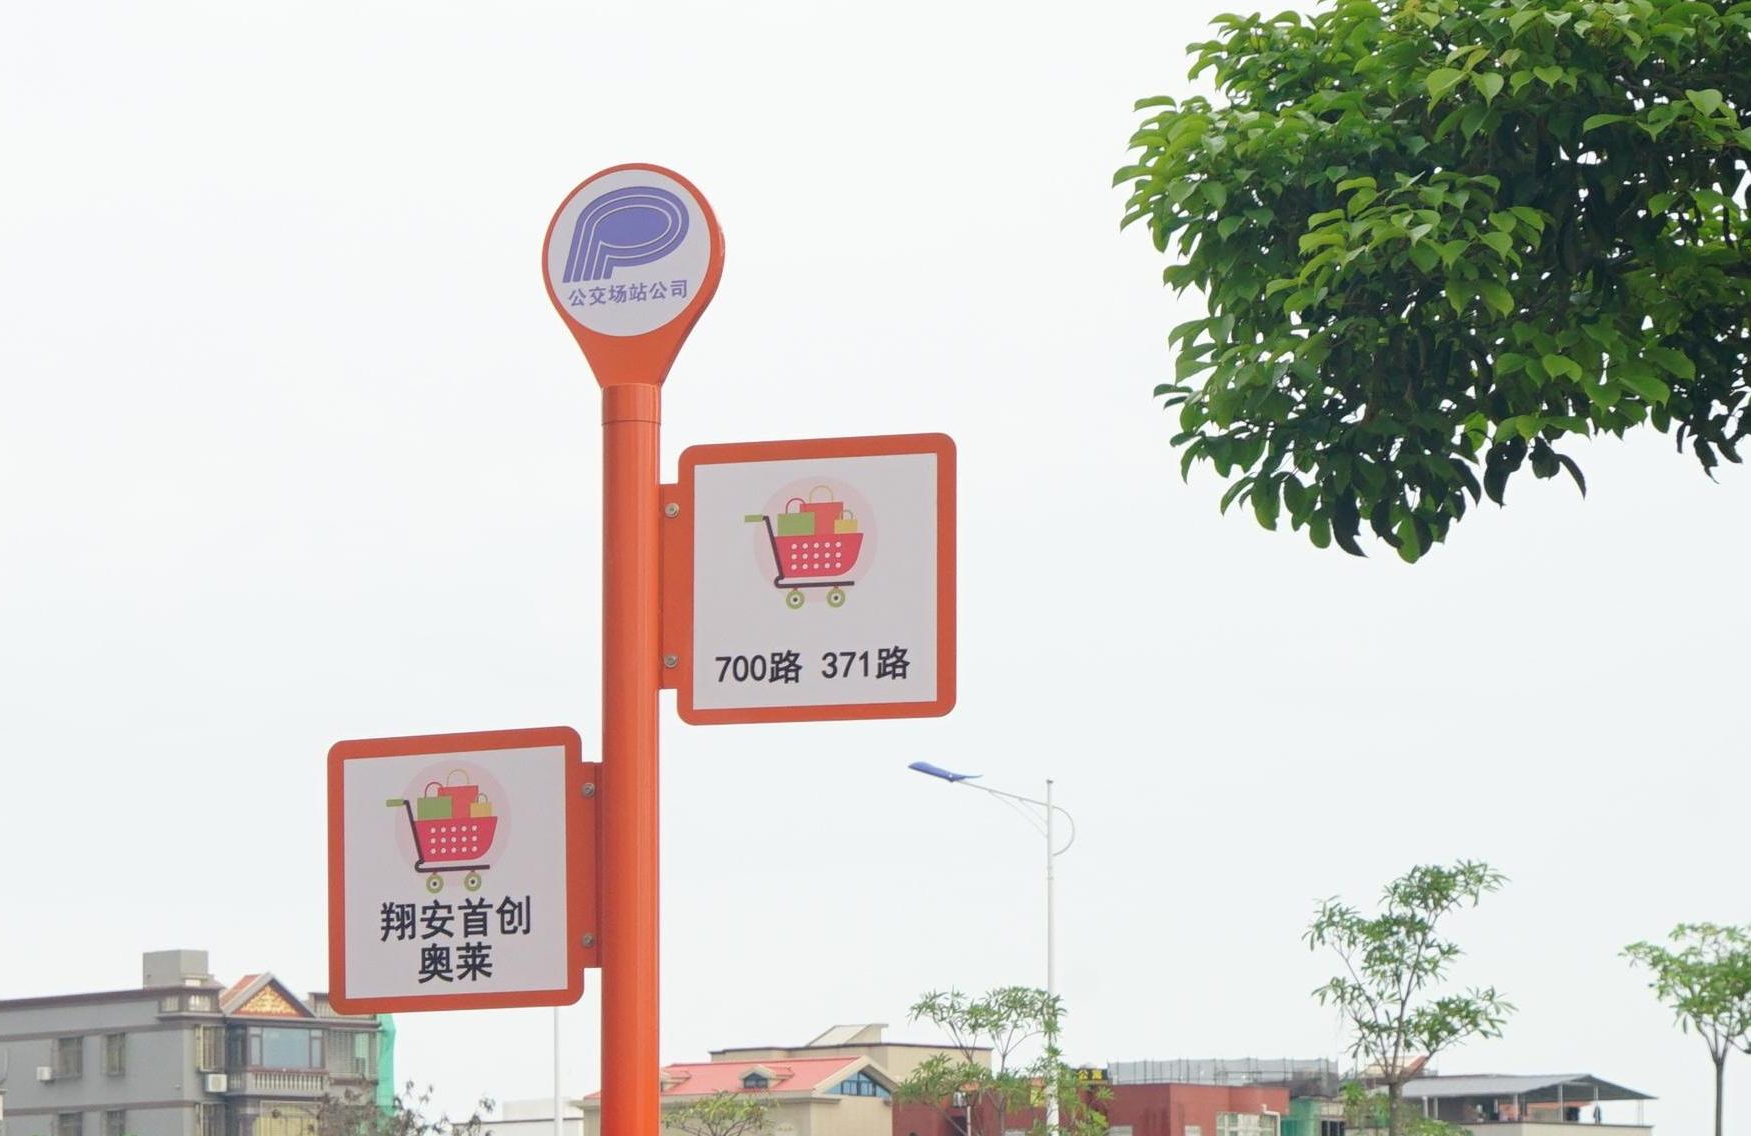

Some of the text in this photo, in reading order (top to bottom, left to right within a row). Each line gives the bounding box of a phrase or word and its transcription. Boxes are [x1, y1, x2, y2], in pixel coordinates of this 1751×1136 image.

[569, 279, 688, 307] 公交场站公司
[715, 645, 910, 684] 700路 371路
[380, 895, 531, 942] 翔安首创
[418, 941, 493, 984] 奥莱
